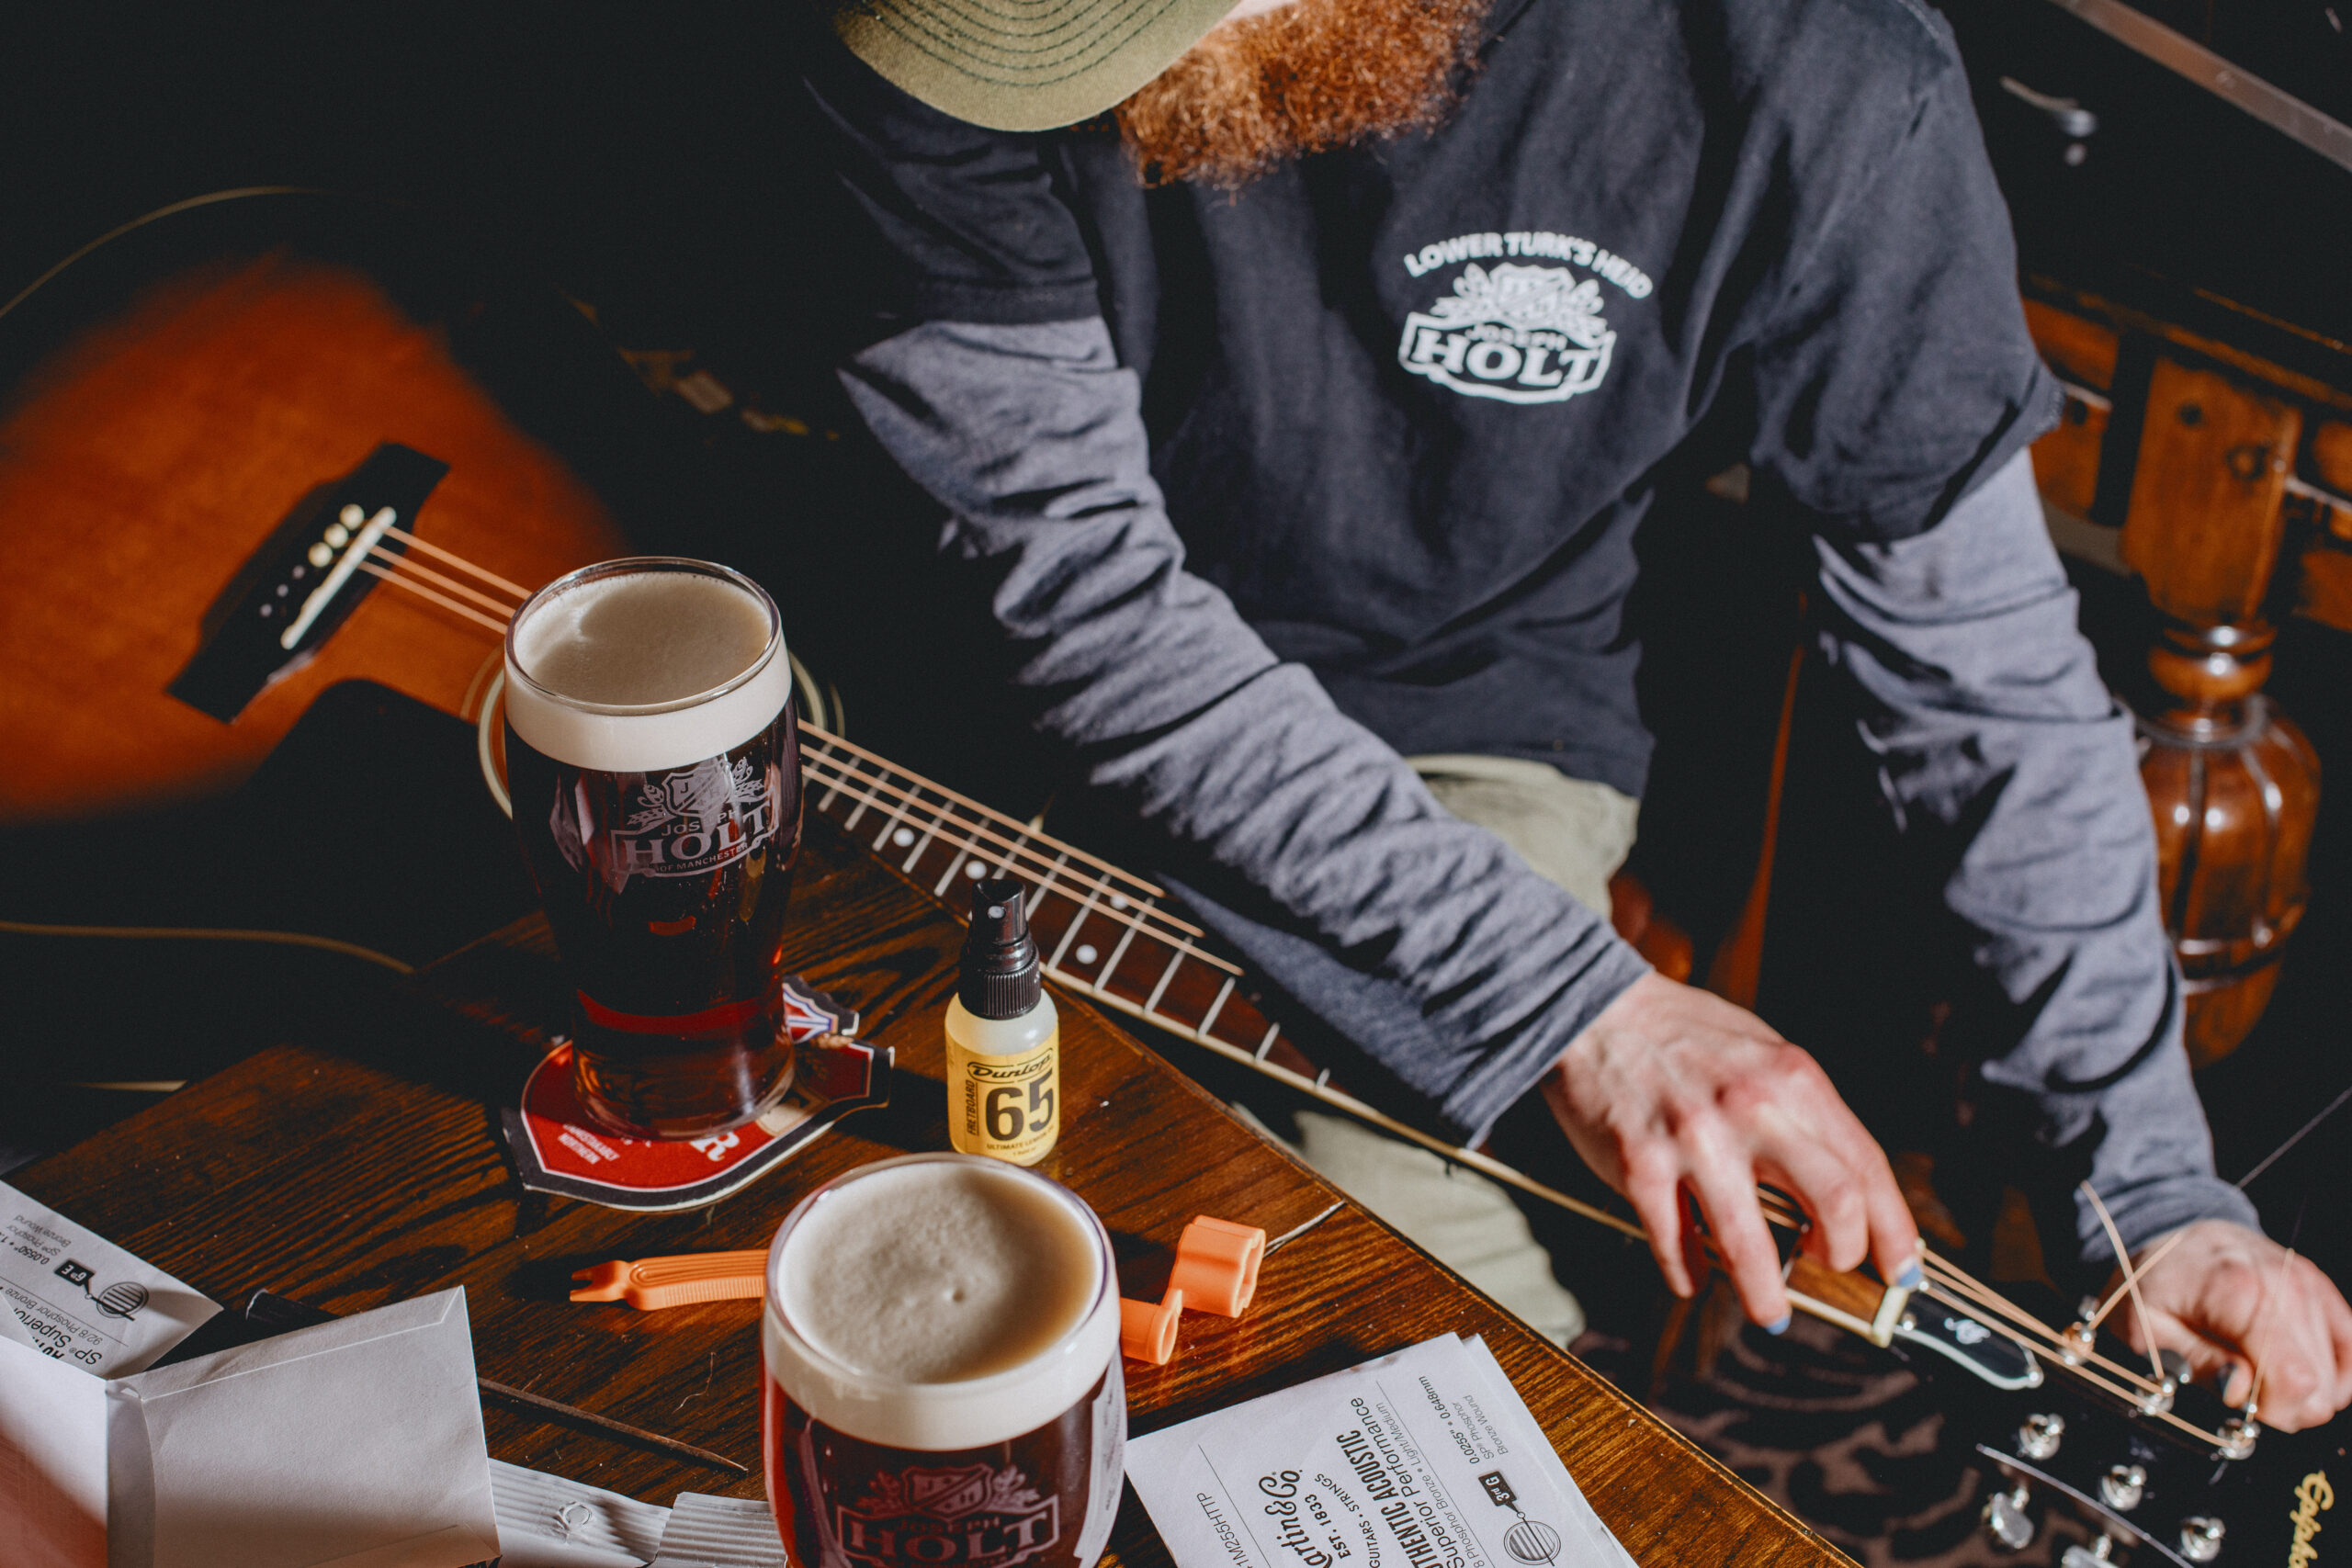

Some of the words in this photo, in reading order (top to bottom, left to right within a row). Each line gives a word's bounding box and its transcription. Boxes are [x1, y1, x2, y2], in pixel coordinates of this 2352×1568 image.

[1404, 232, 1503, 277] LOWER
[1504, 231, 1597, 266] TURK'S
[1591, 249, 1653, 299] HEAD
[1411, 329, 1600, 386] HOLT
[1465, 323, 1567, 352] JOSEPH
[625, 801, 771, 865] HOLT
[676, 842, 748, 870] MANCHESTER
[972, 1054, 1052, 1078] Dunlop
[965, 1080, 976, 1136] FRETBOARD
[986, 1067, 1054, 1141] 65
[5, 1287, 38, 1309] Bronze
[37, 1307, 81, 1333] Phosphor
[1419, 1375, 1451, 1419] 0.648mm
[1463, 1394, 1487, 1425] Wound
[1376, 1402, 1421, 1467] Light/Medium
[1452, 1402, 1483, 1441] Phosphor
[1485, 1425, 1509, 1455] Bronze
[1336, 1430, 1399, 1501] ACOUSTIC
[1351, 1397, 1420, 1497] Performance
[1449, 1429, 1480, 1464] 0.0255"
[1305, 1494, 1331, 1526] 1833
[1314, 1472, 1360, 1513] STRINGS
[1422, 1474, 1449, 1509] Bronze
[850, 1512, 1047, 1561] HOLT
[1196, 1493, 1252, 1568] 1M255HTTP
[1359, 1520, 1381, 1568] GUITARS
[1413, 1500, 1465, 1568] Superior
[1444, 1511, 1480, 1559] Phosphor
